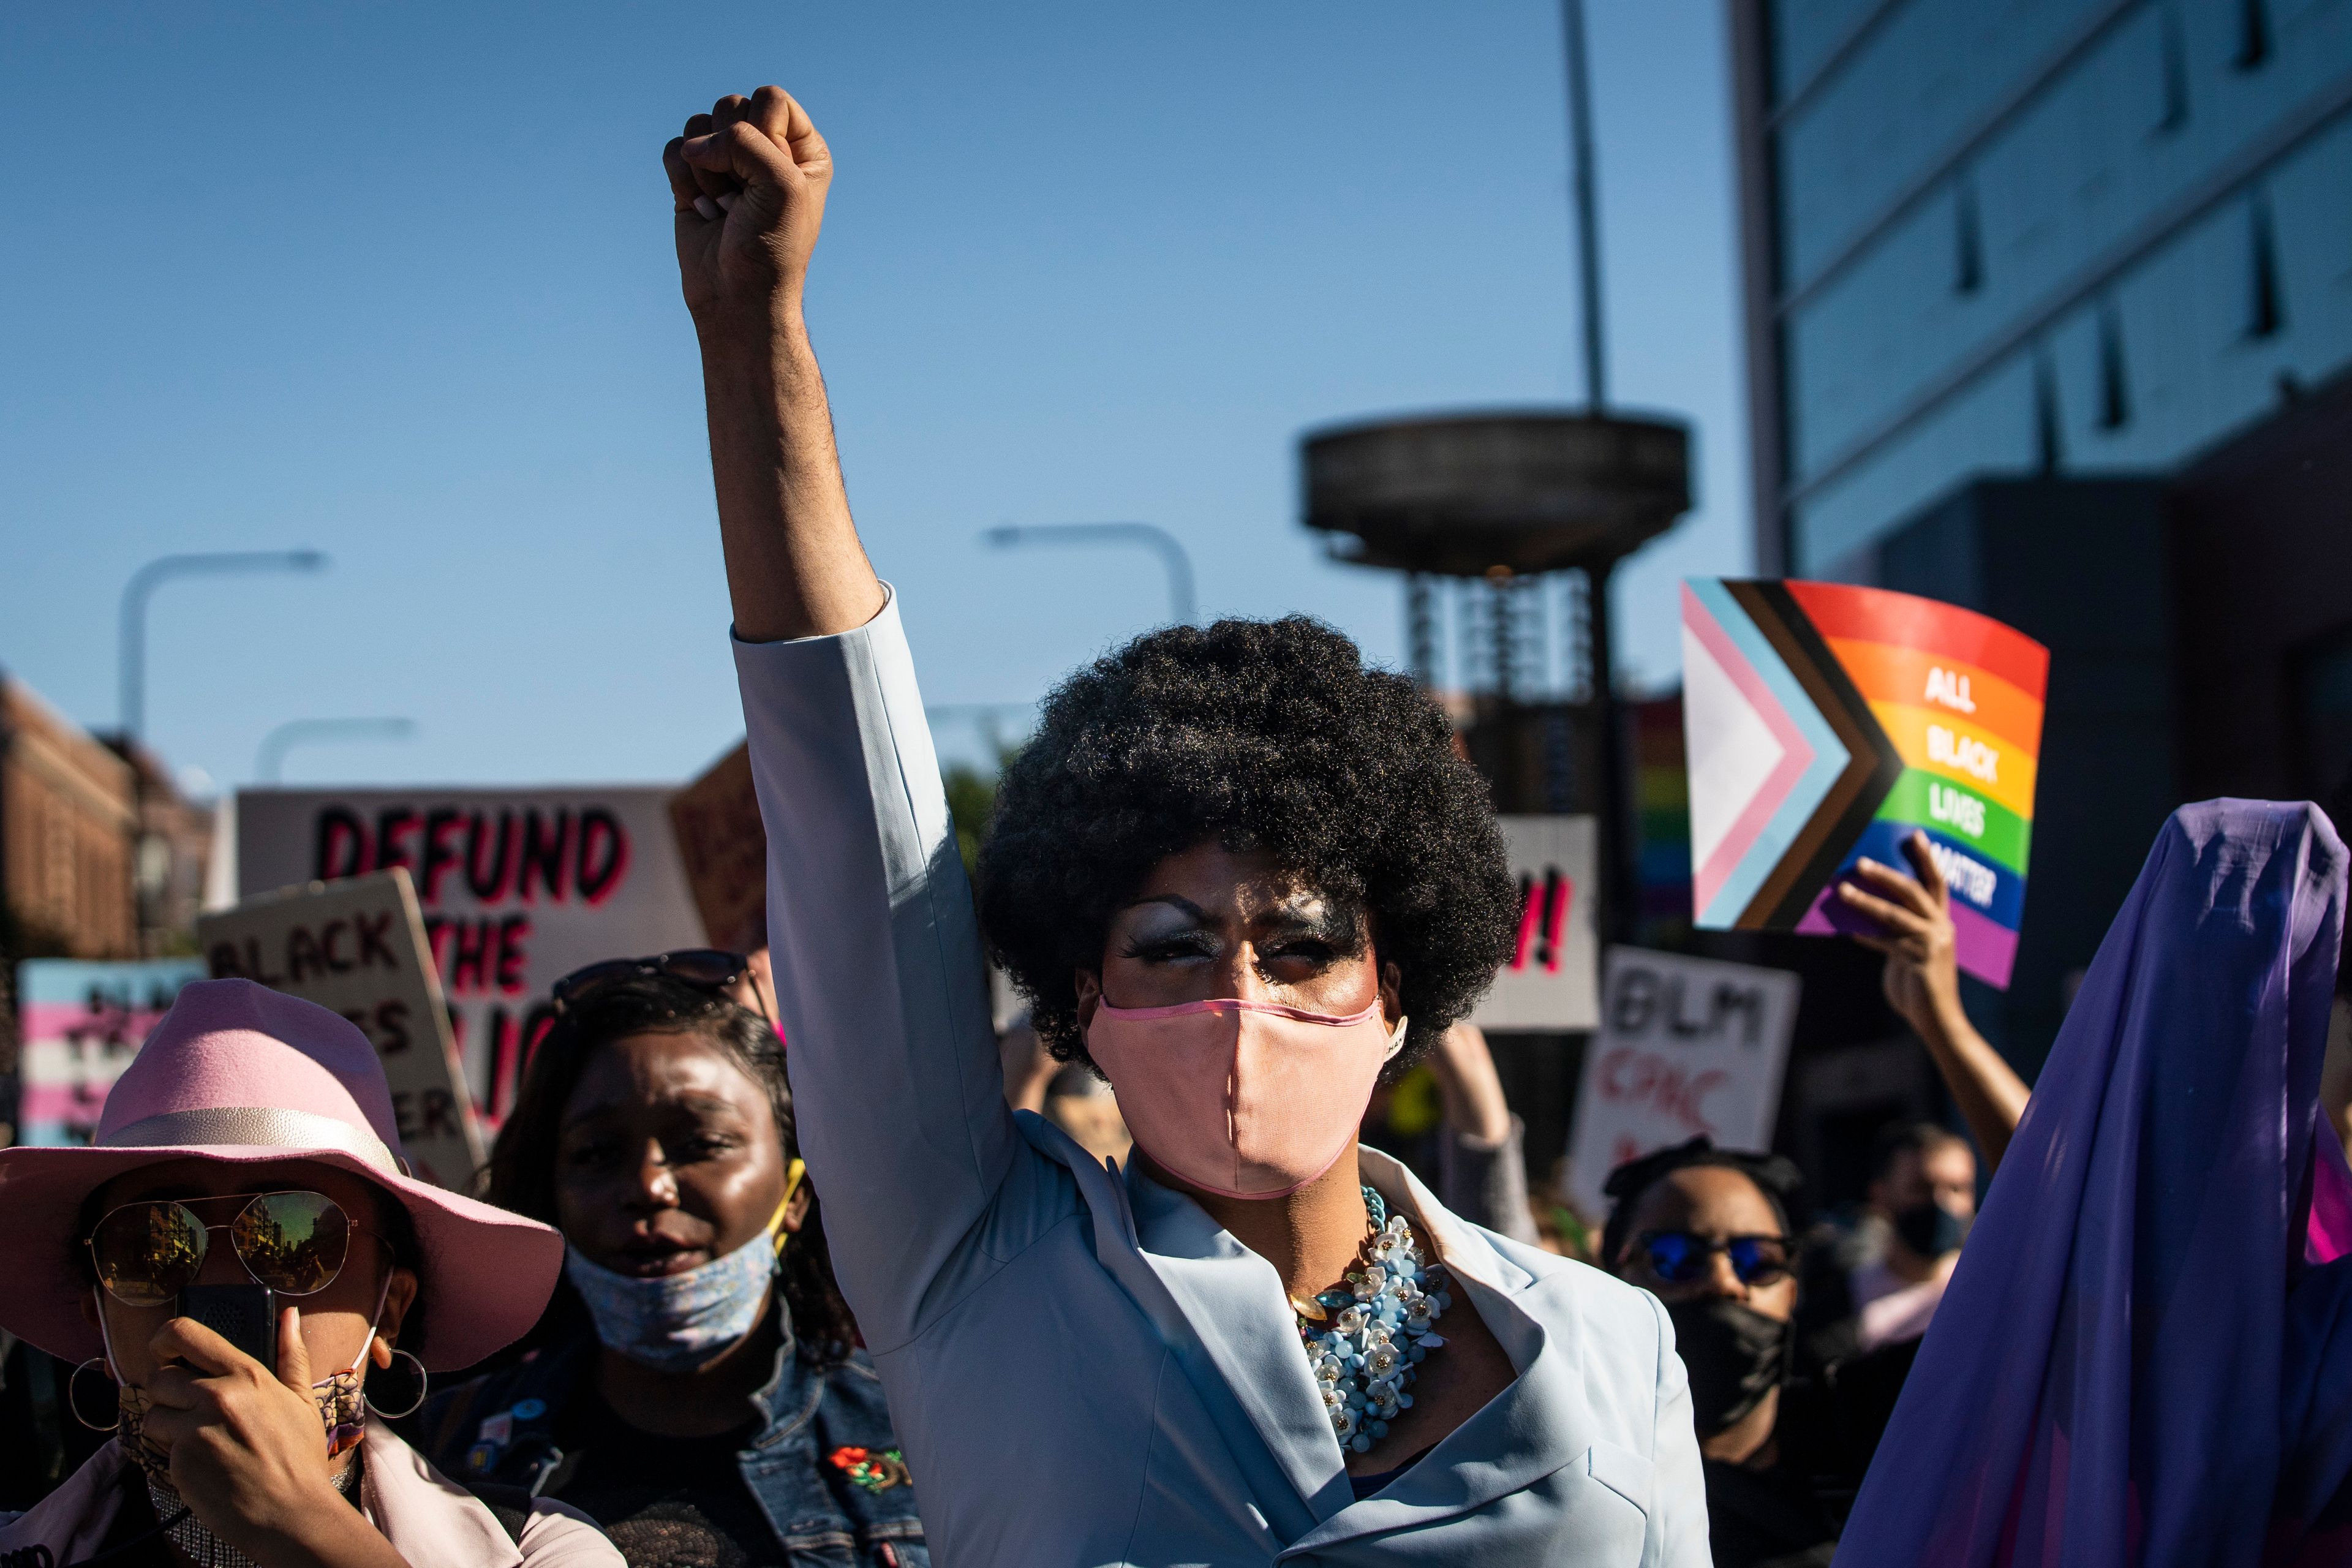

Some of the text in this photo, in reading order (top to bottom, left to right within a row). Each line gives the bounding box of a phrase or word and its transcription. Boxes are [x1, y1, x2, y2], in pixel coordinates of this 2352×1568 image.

[1924, 666, 1977, 714] ALL
[1927, 724, 2000, 783] BLACK
[1929, 782, 1986, 838] LIVES
[320, 806, 627, 905] DEFUND
[211, 911, 399, 984] BLACK
[1611, 968, 1765, 1050] BLM
